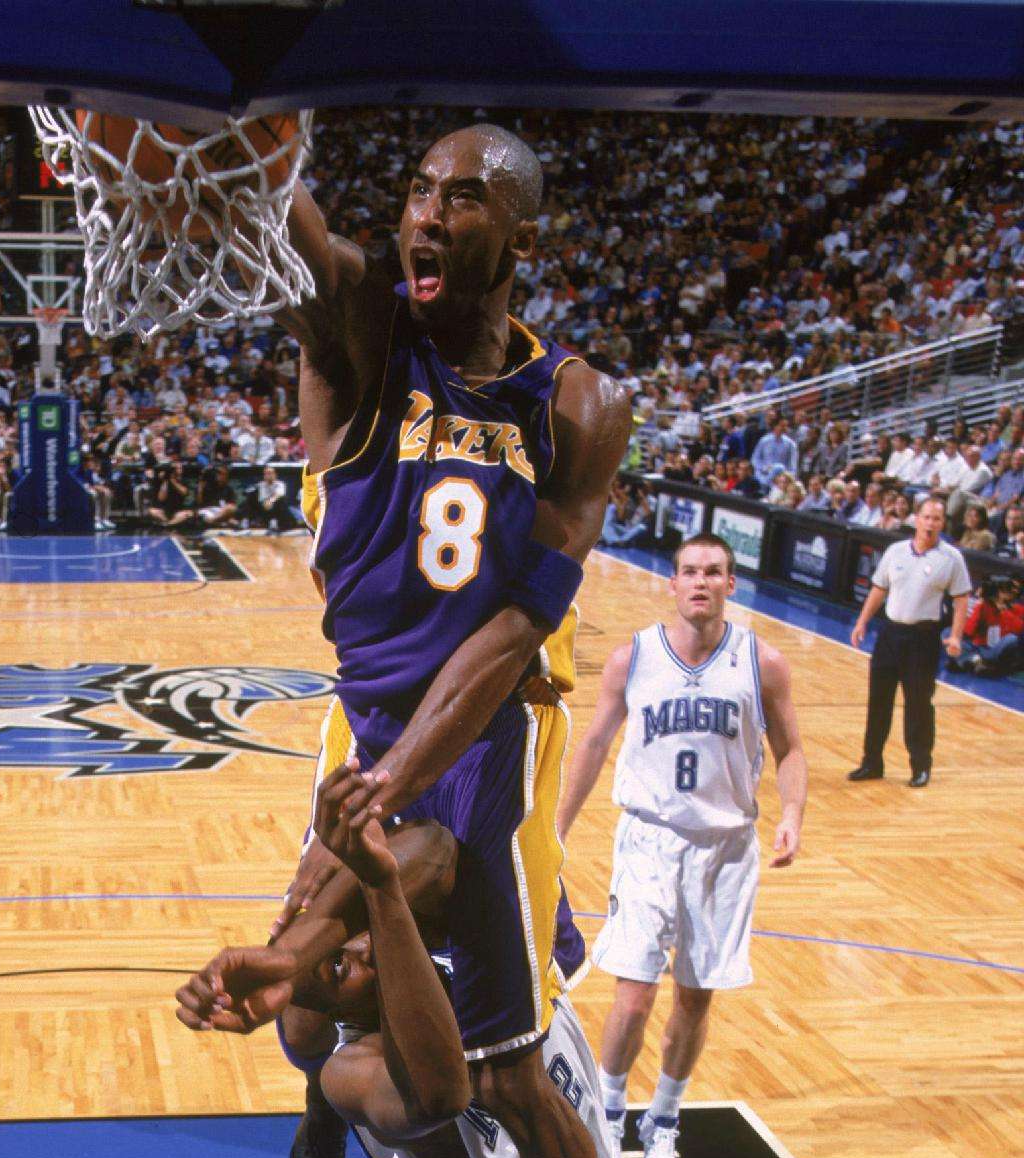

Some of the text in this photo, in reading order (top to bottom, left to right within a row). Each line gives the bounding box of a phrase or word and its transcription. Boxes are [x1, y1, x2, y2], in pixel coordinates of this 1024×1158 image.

[398, 390, 535, 484] LAKER
[418, 476, 488, 592] 8
[642, 696, 739, 747] MAGIC
[675, 750, 698, 793] 8
